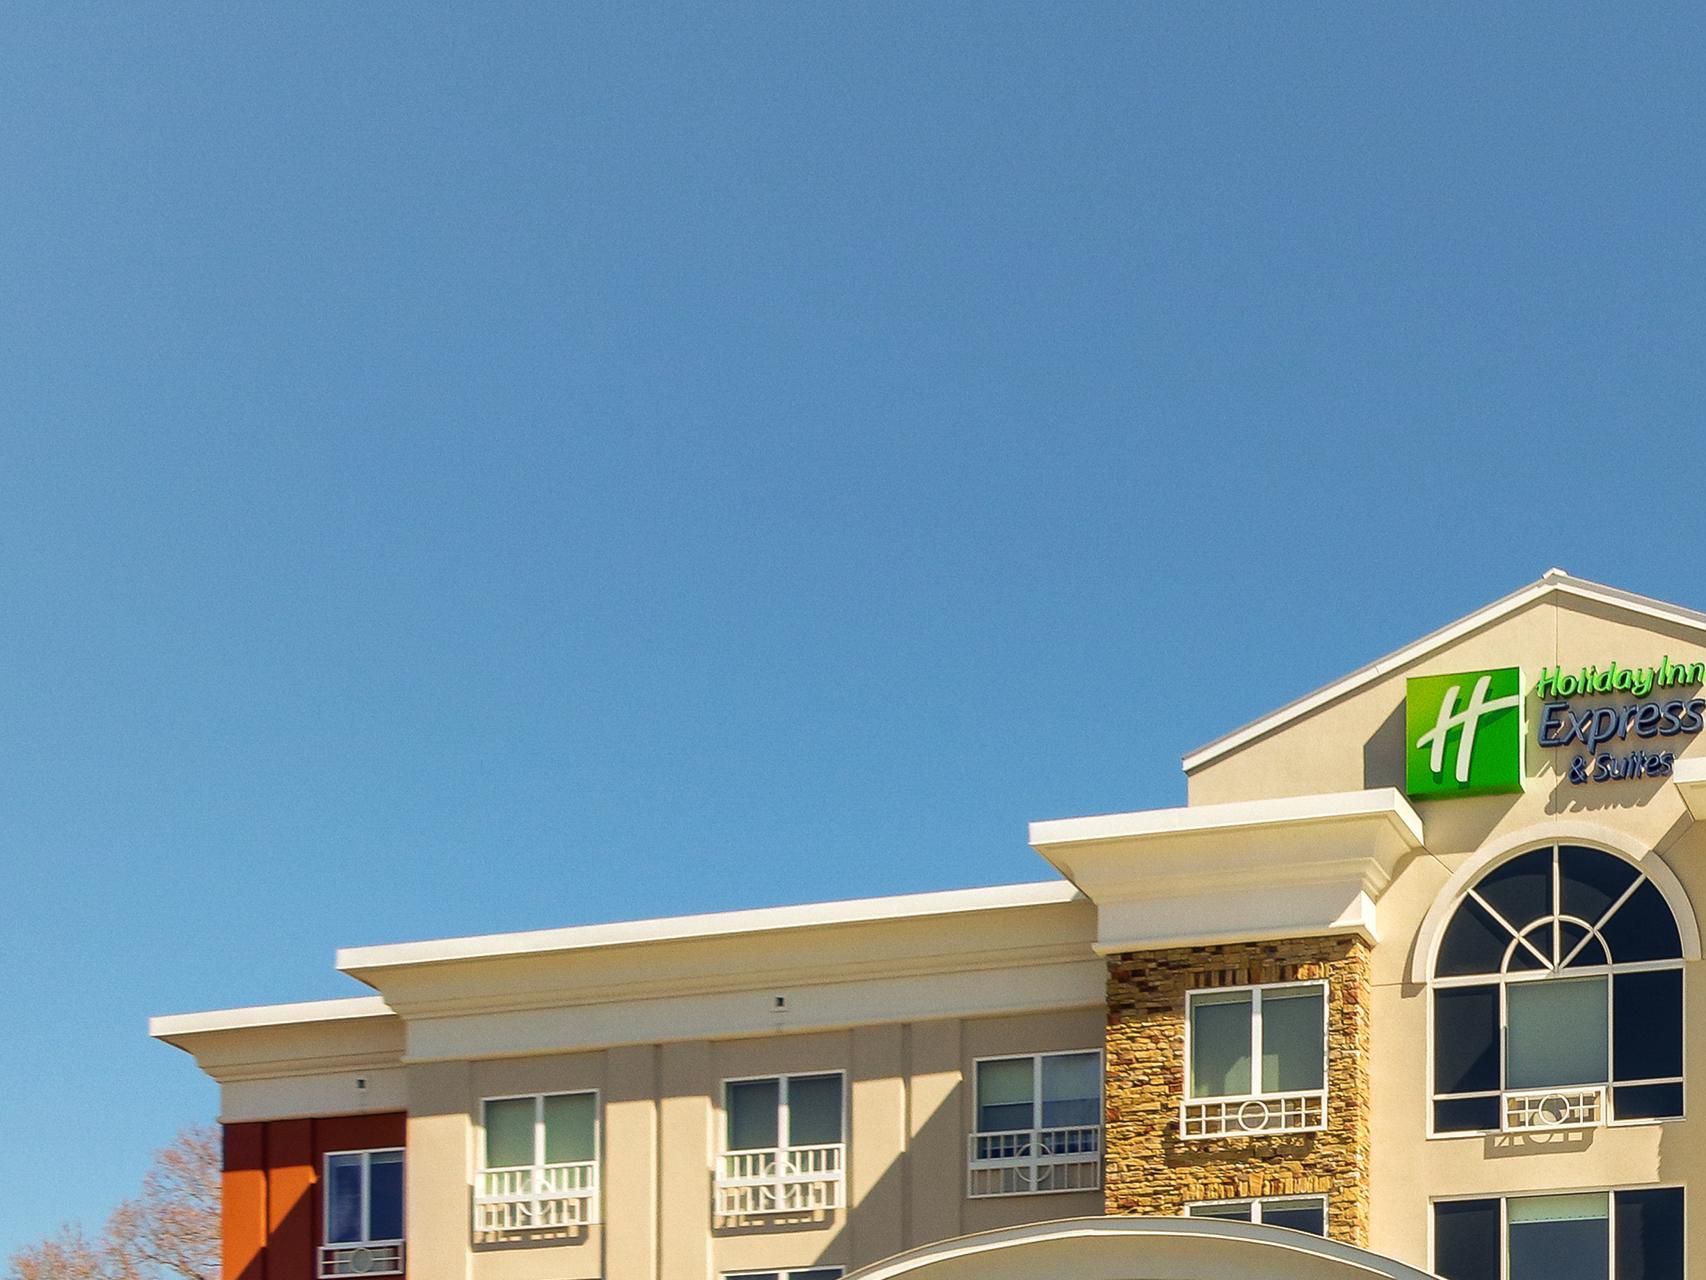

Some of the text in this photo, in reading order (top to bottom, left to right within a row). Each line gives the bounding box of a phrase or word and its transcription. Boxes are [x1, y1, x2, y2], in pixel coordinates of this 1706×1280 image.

[1537, 655, 1706, 699] Holiday Inn
[1538, 699, 1706, 754] Express
[1568, 751, 1674, 785] & Suites
